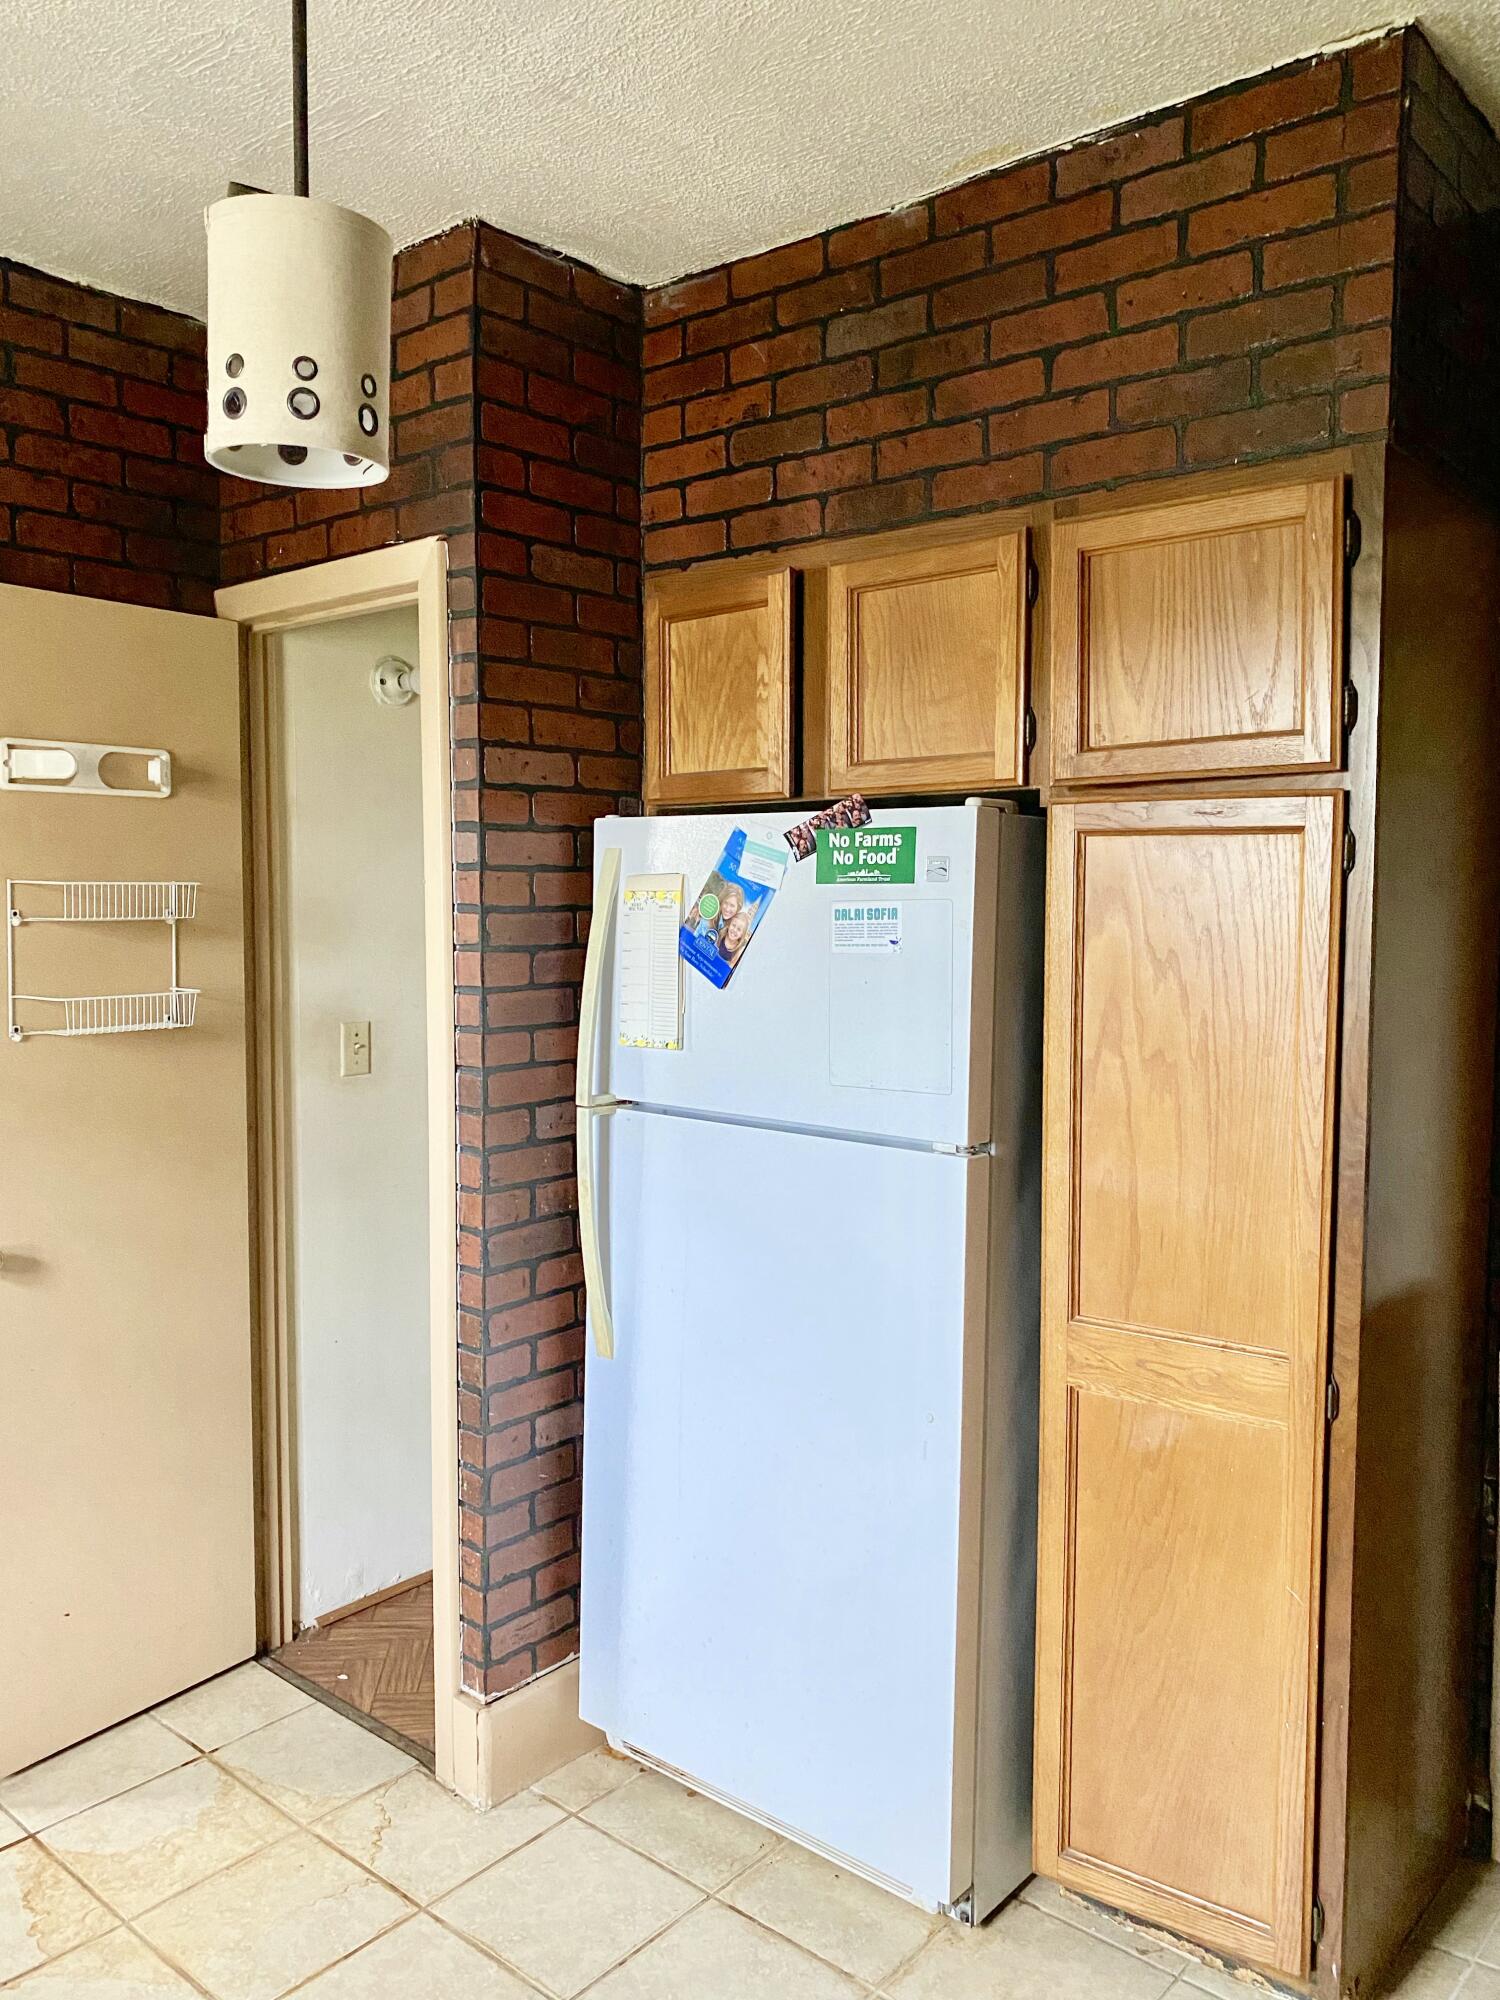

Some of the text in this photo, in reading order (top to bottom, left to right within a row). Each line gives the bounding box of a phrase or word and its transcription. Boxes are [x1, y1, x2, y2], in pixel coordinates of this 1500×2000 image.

[829, 831, 902, 848] No Farms
[833, 847, 897, 865] No Food
[866, 907, 898, 920] SOFIA
